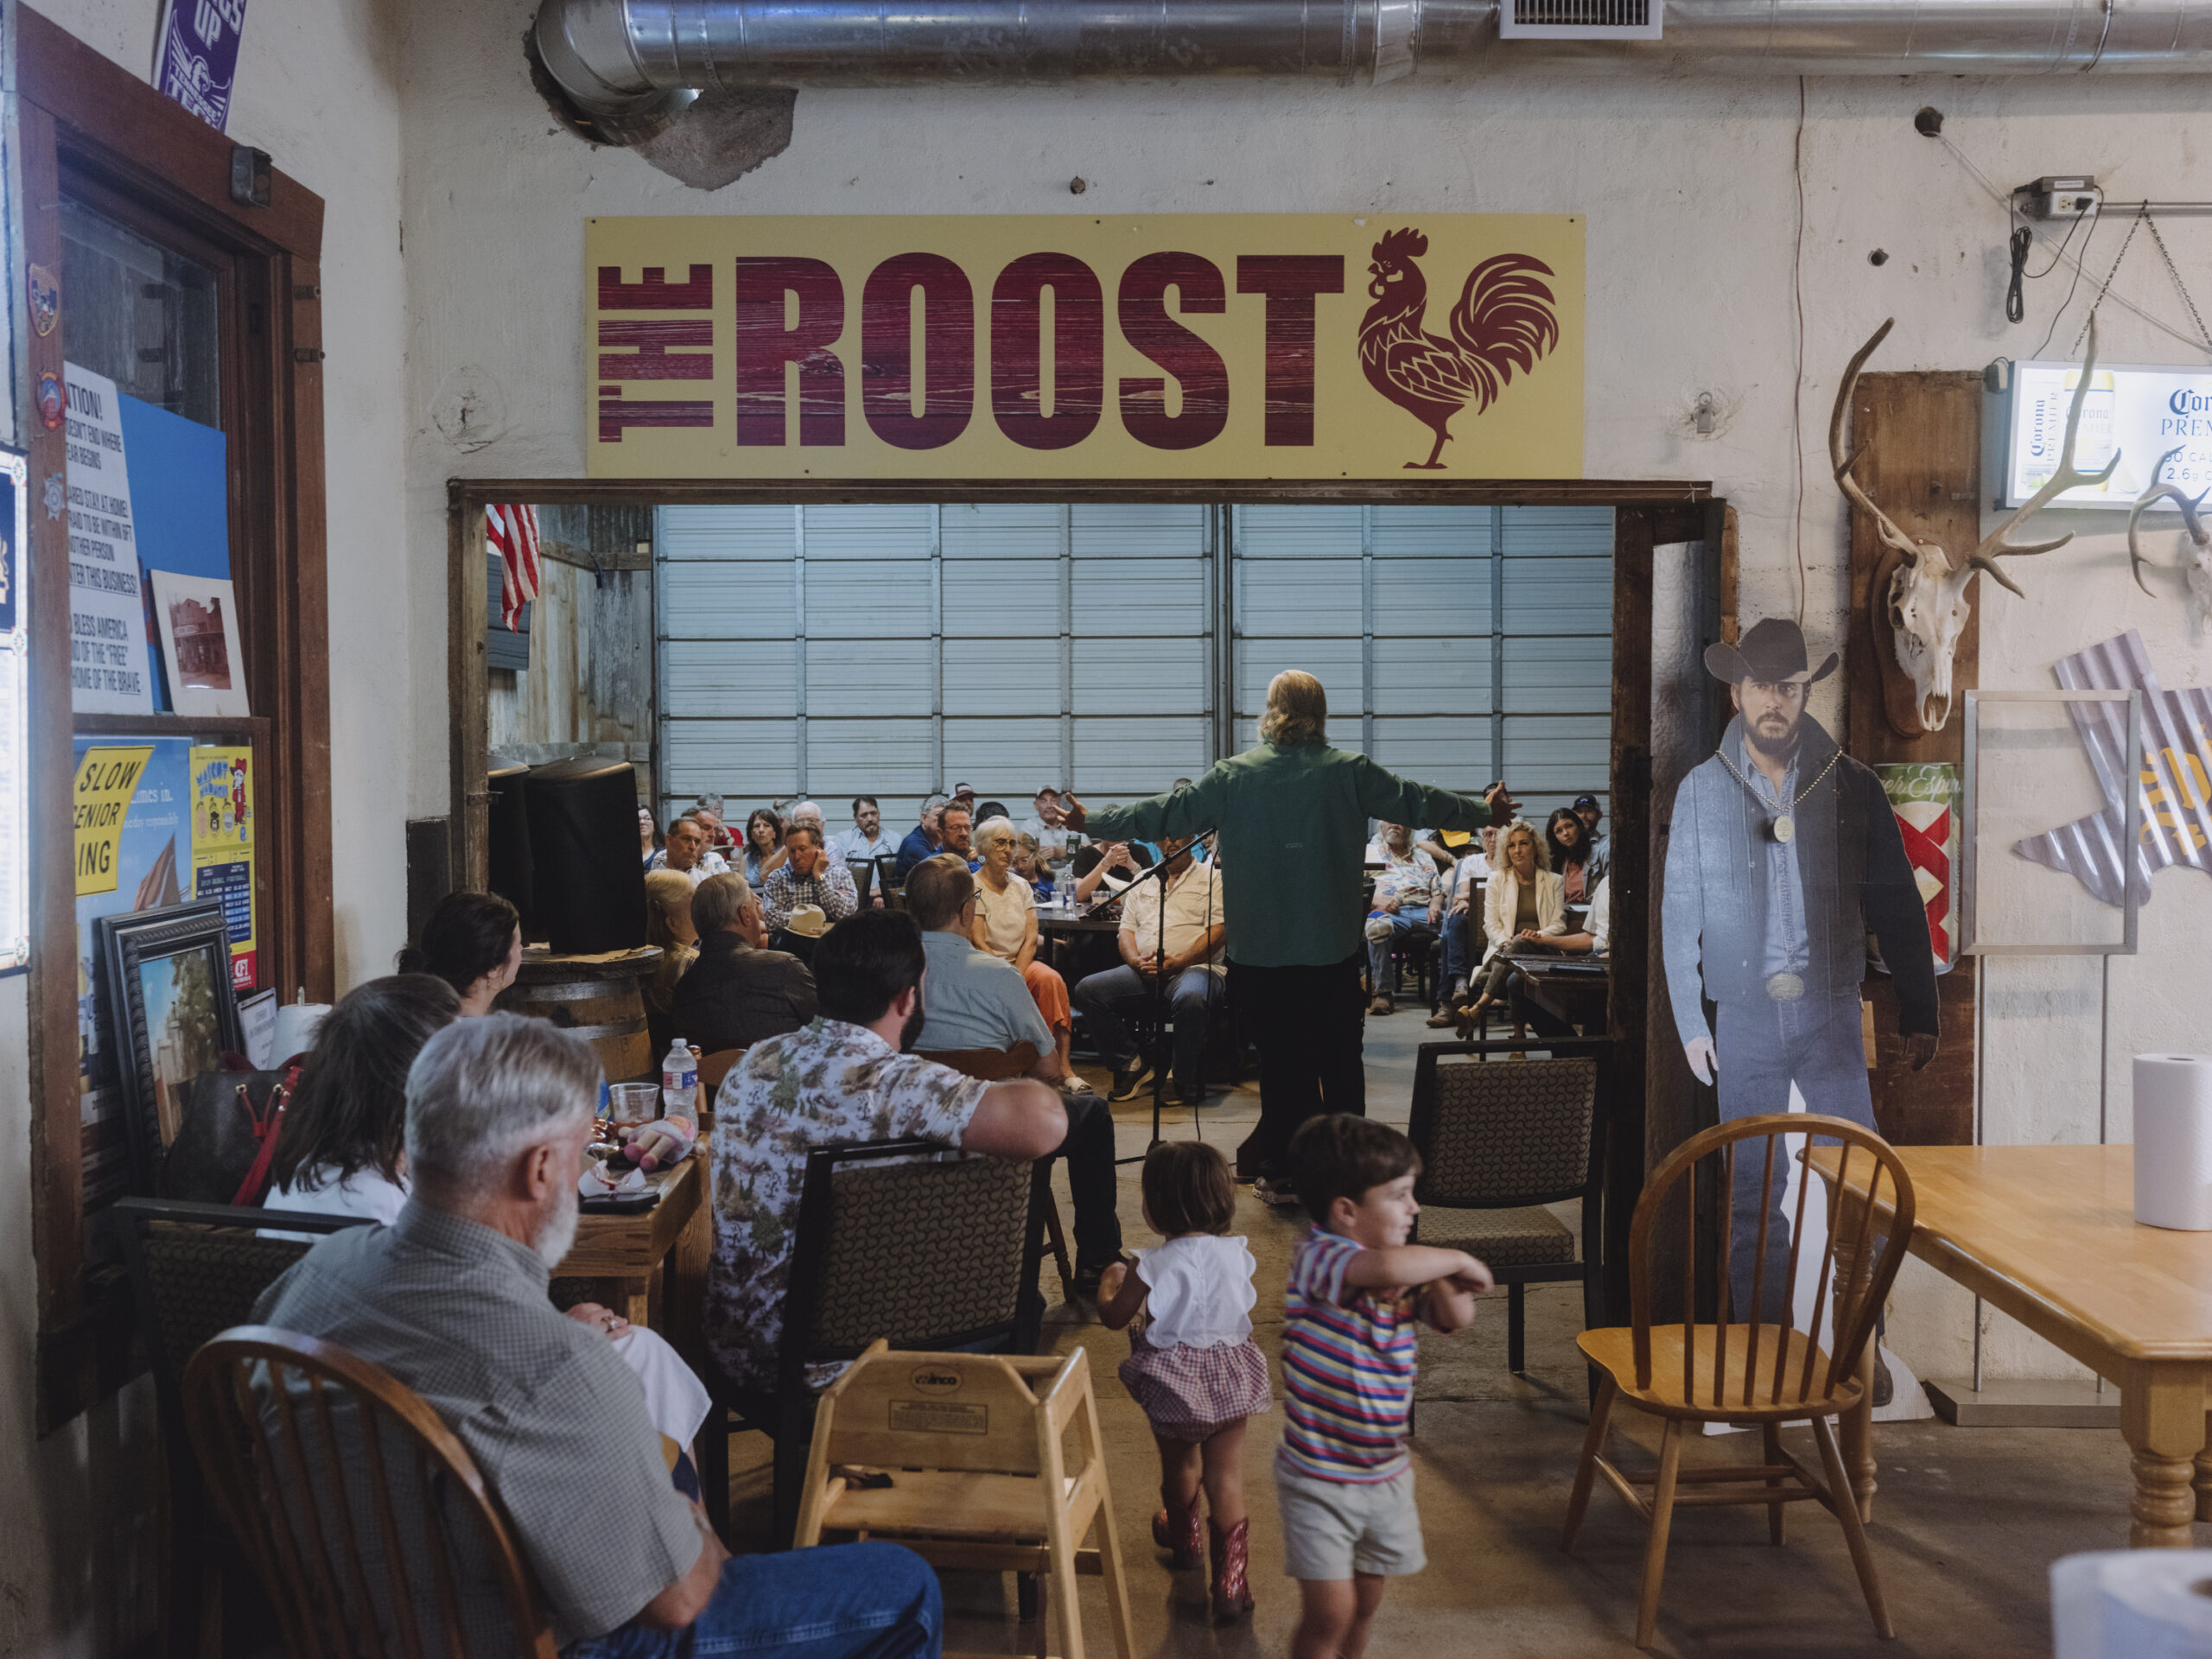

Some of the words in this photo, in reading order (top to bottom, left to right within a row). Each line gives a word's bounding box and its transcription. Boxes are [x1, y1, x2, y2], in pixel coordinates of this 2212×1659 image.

[194, 0, 222, 51] UP
[597, 264, 714, 443] THE
[735, 251, 1344, 450] ROOST
[67, 382, 104, 422] TION!
[2066, 406, 2109, 421] rona
[87, 424, 101, 446] END
[99, 429, 123, 453] WHERE
[2030, 399, 2046, 457] Corona
[79, 446, 102, 470] BEGINS
[84, 489, 100, 510] STAY
[100, 493, 109, 512] AT
[82, 513, 92, 532] TO
[92, 516, 101, 534] BE
[100, 518, 122, 540] WITHIN
[90, 539, 115, 562] PERSON
[85, 565, 102, 588] THIS
[73, 612, 96, 637] BLESS
[97, 616, 129, 641] AMERICA
[80, 640, 91, 662] OF
[90, 641, 105, 664] THE
[92, 668, 102, 690] OF
[102, 669, 118, 691] THE
[117, 671, 141, 693] BRAVE
[79, 760, 142, 792] SLOW
